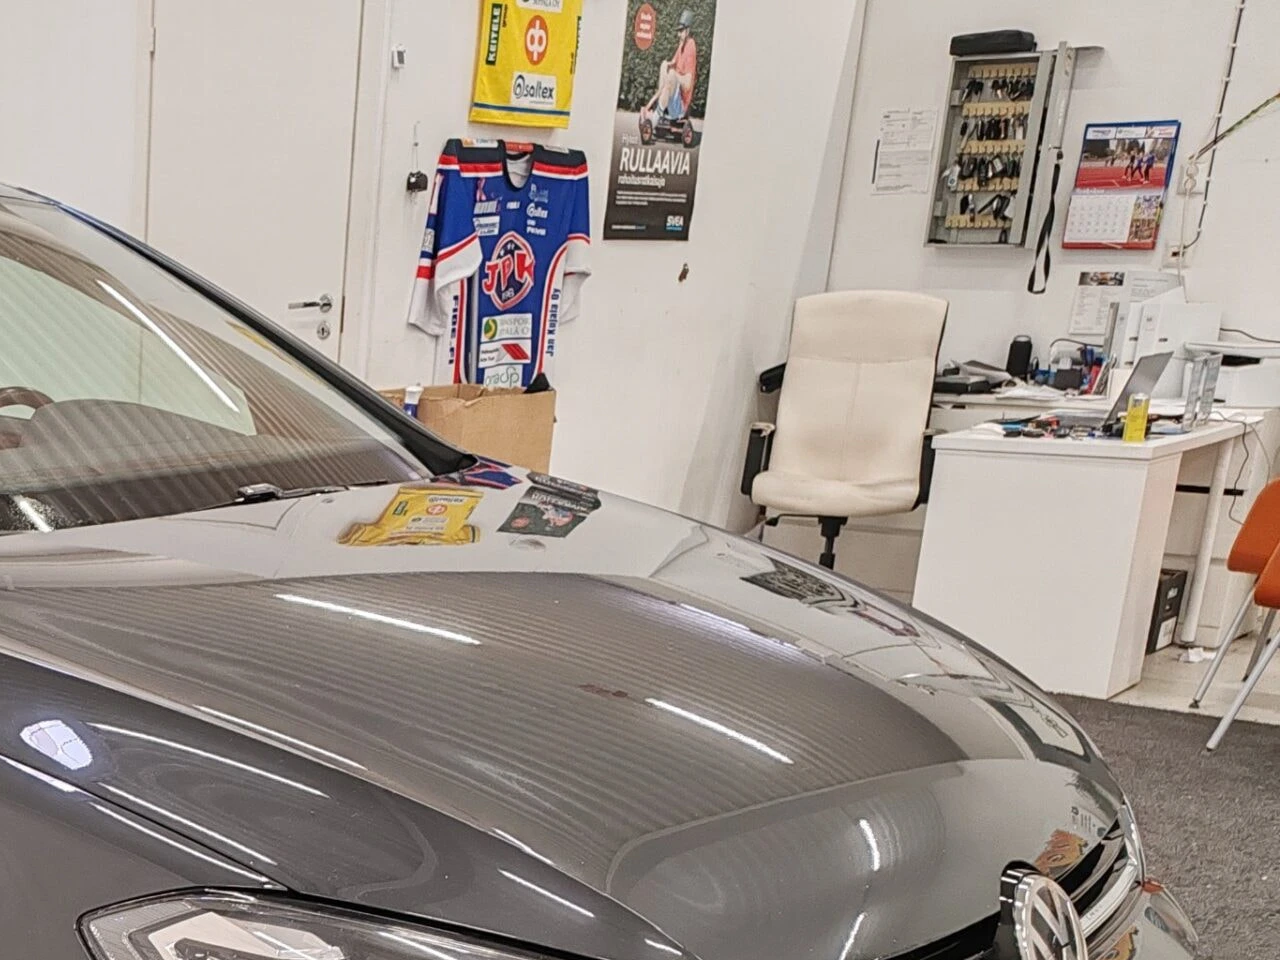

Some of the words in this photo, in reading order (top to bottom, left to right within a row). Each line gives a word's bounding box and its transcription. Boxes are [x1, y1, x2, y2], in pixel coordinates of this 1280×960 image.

[487, 7, 501, 61] KEITELE
[620, 147, 691, 175] RULLAAVIA
[482, 251, 535, 294] JPK
